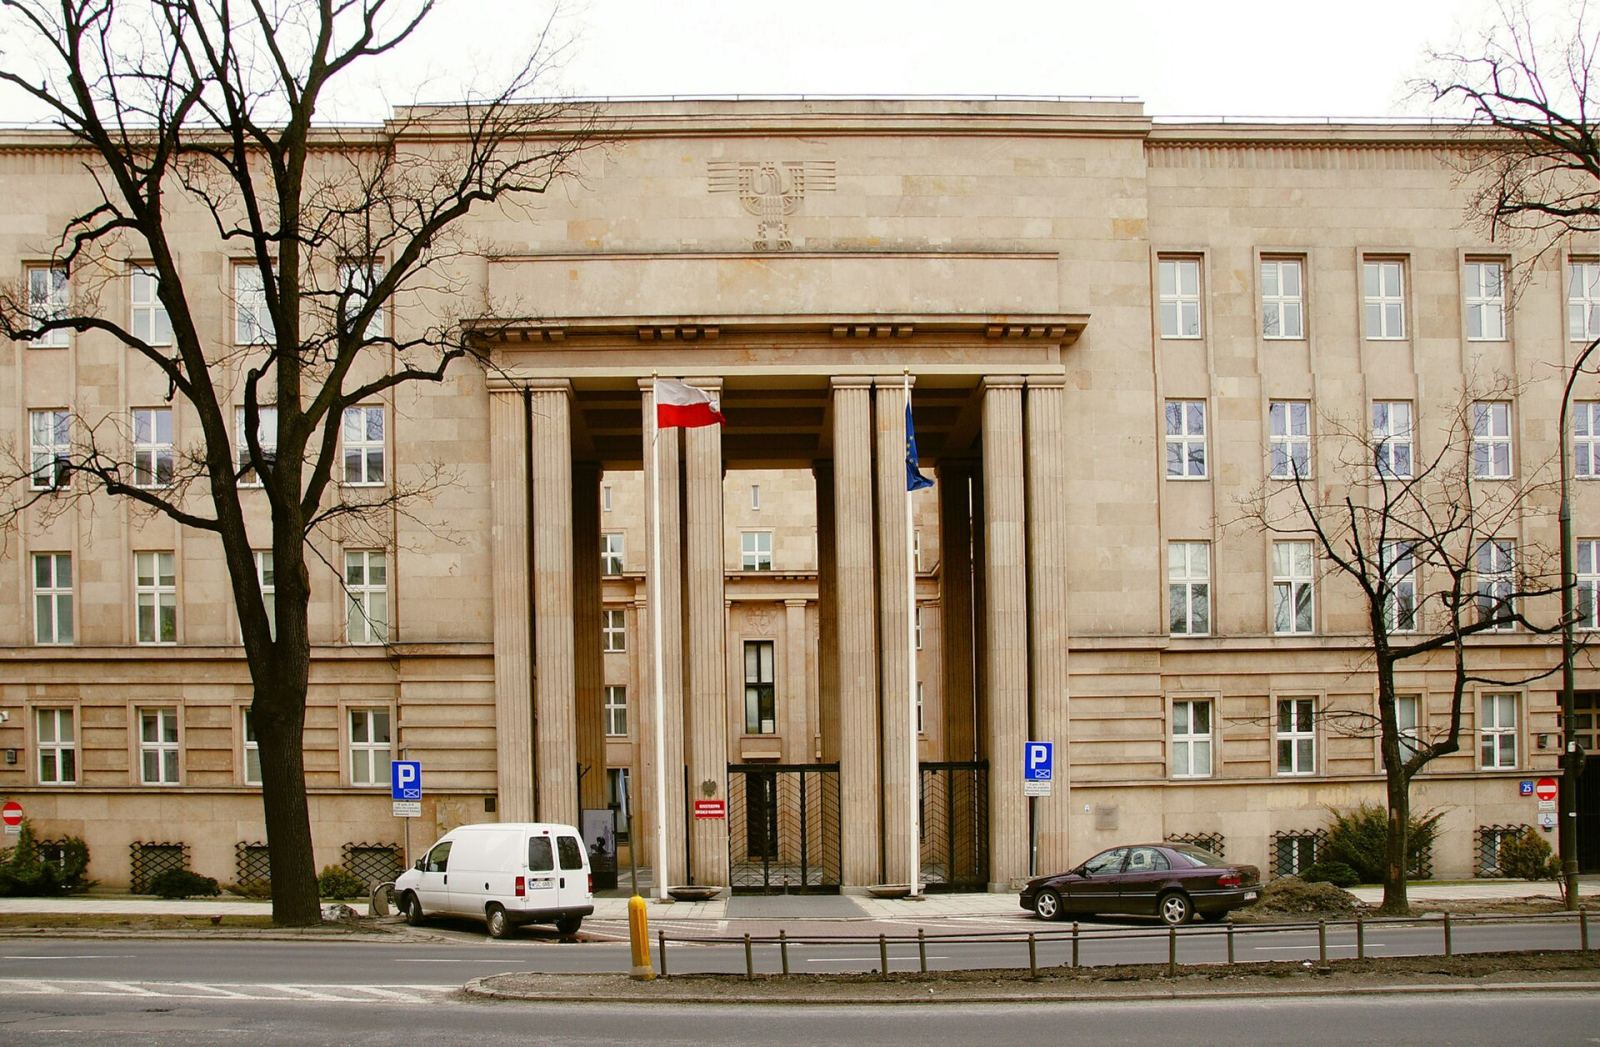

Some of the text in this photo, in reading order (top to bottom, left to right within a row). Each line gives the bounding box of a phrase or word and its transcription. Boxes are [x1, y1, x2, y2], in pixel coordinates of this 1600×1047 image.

[1031, 745, 1047, 769] P
[398, 764, 415, 789] P
[1523, 784, 1532, 792] 25
